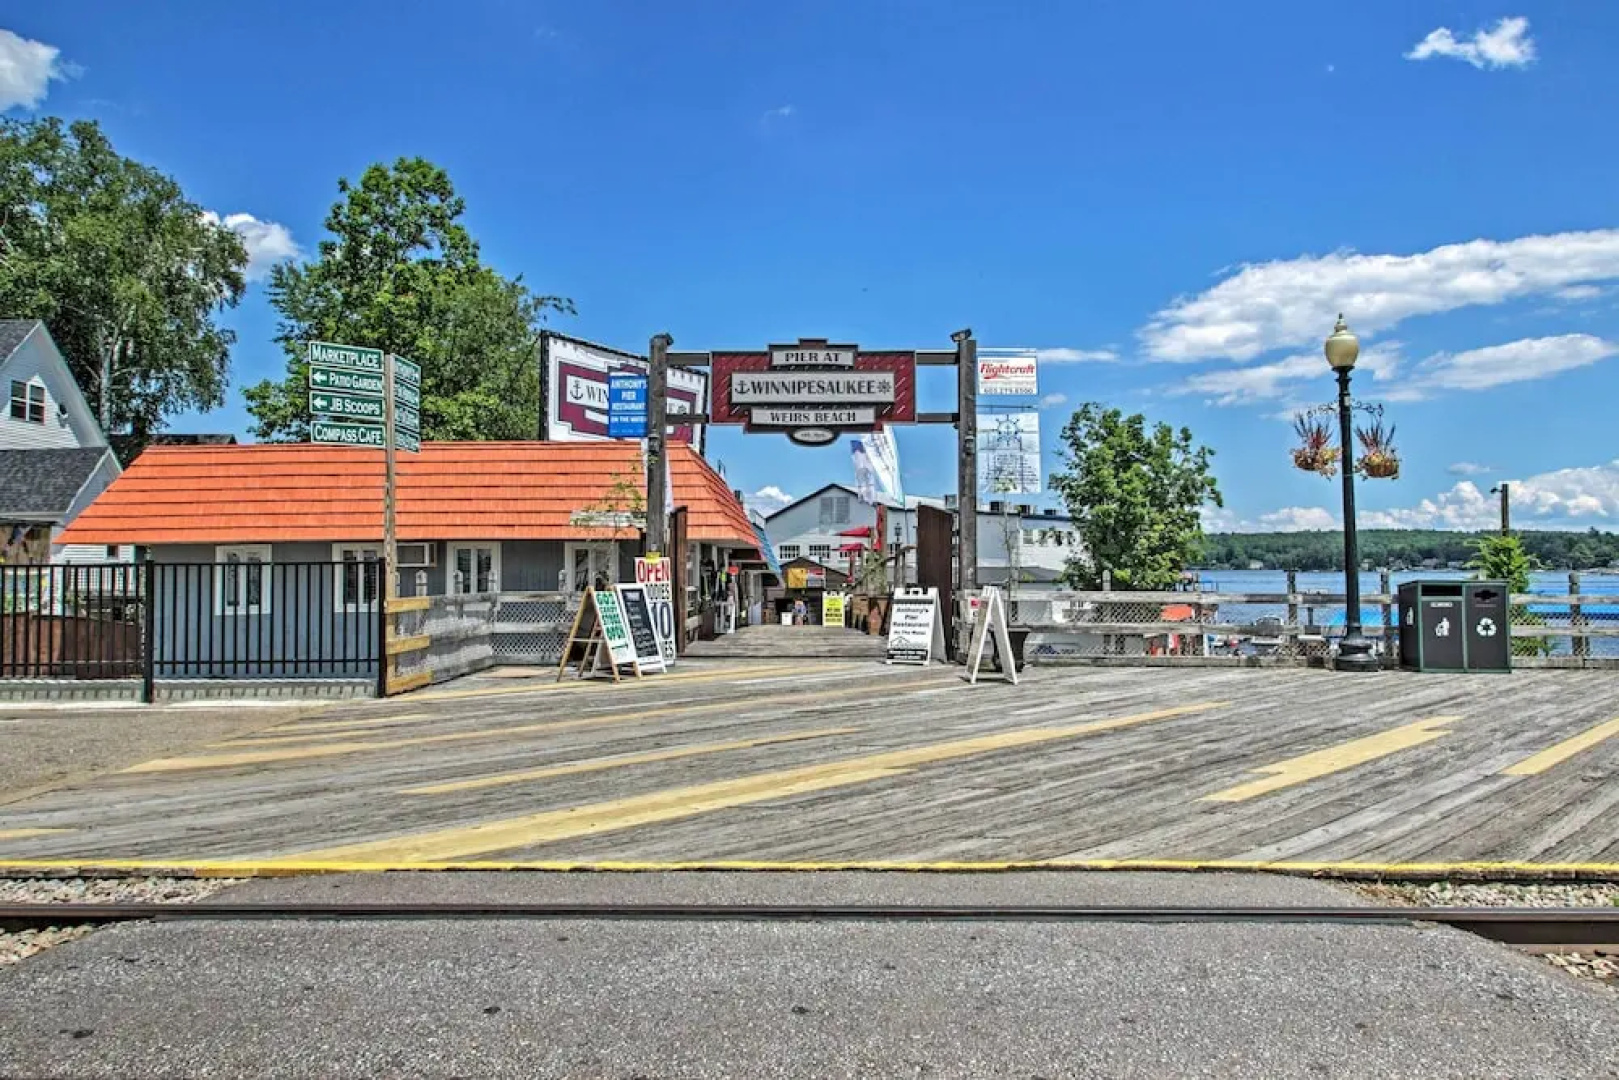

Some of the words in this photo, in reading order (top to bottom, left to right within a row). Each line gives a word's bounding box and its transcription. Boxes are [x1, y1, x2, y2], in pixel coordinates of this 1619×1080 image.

[312, 344, 380, 367] MARKETPLACE
[784, 352, 818, 362] PIER
[823, 352, 842, 362] AT
[329, 372, 351, 387] PATIO
[353, 375, 383, 390] GARDEN
[750, 379, 875, 395] WINNIPESAUKEE
[330, 398, 343, 411] JB
[344, 399, 380, 415] SCOOPS
[770, 411, 810, 422] WEIRS
[814, 411, 856, 422] BEACH
[315, 425, 356, 440] COMPASS
[358, 428, 382, 443] CAFE
[638, 560, 669, 583] OPEN
